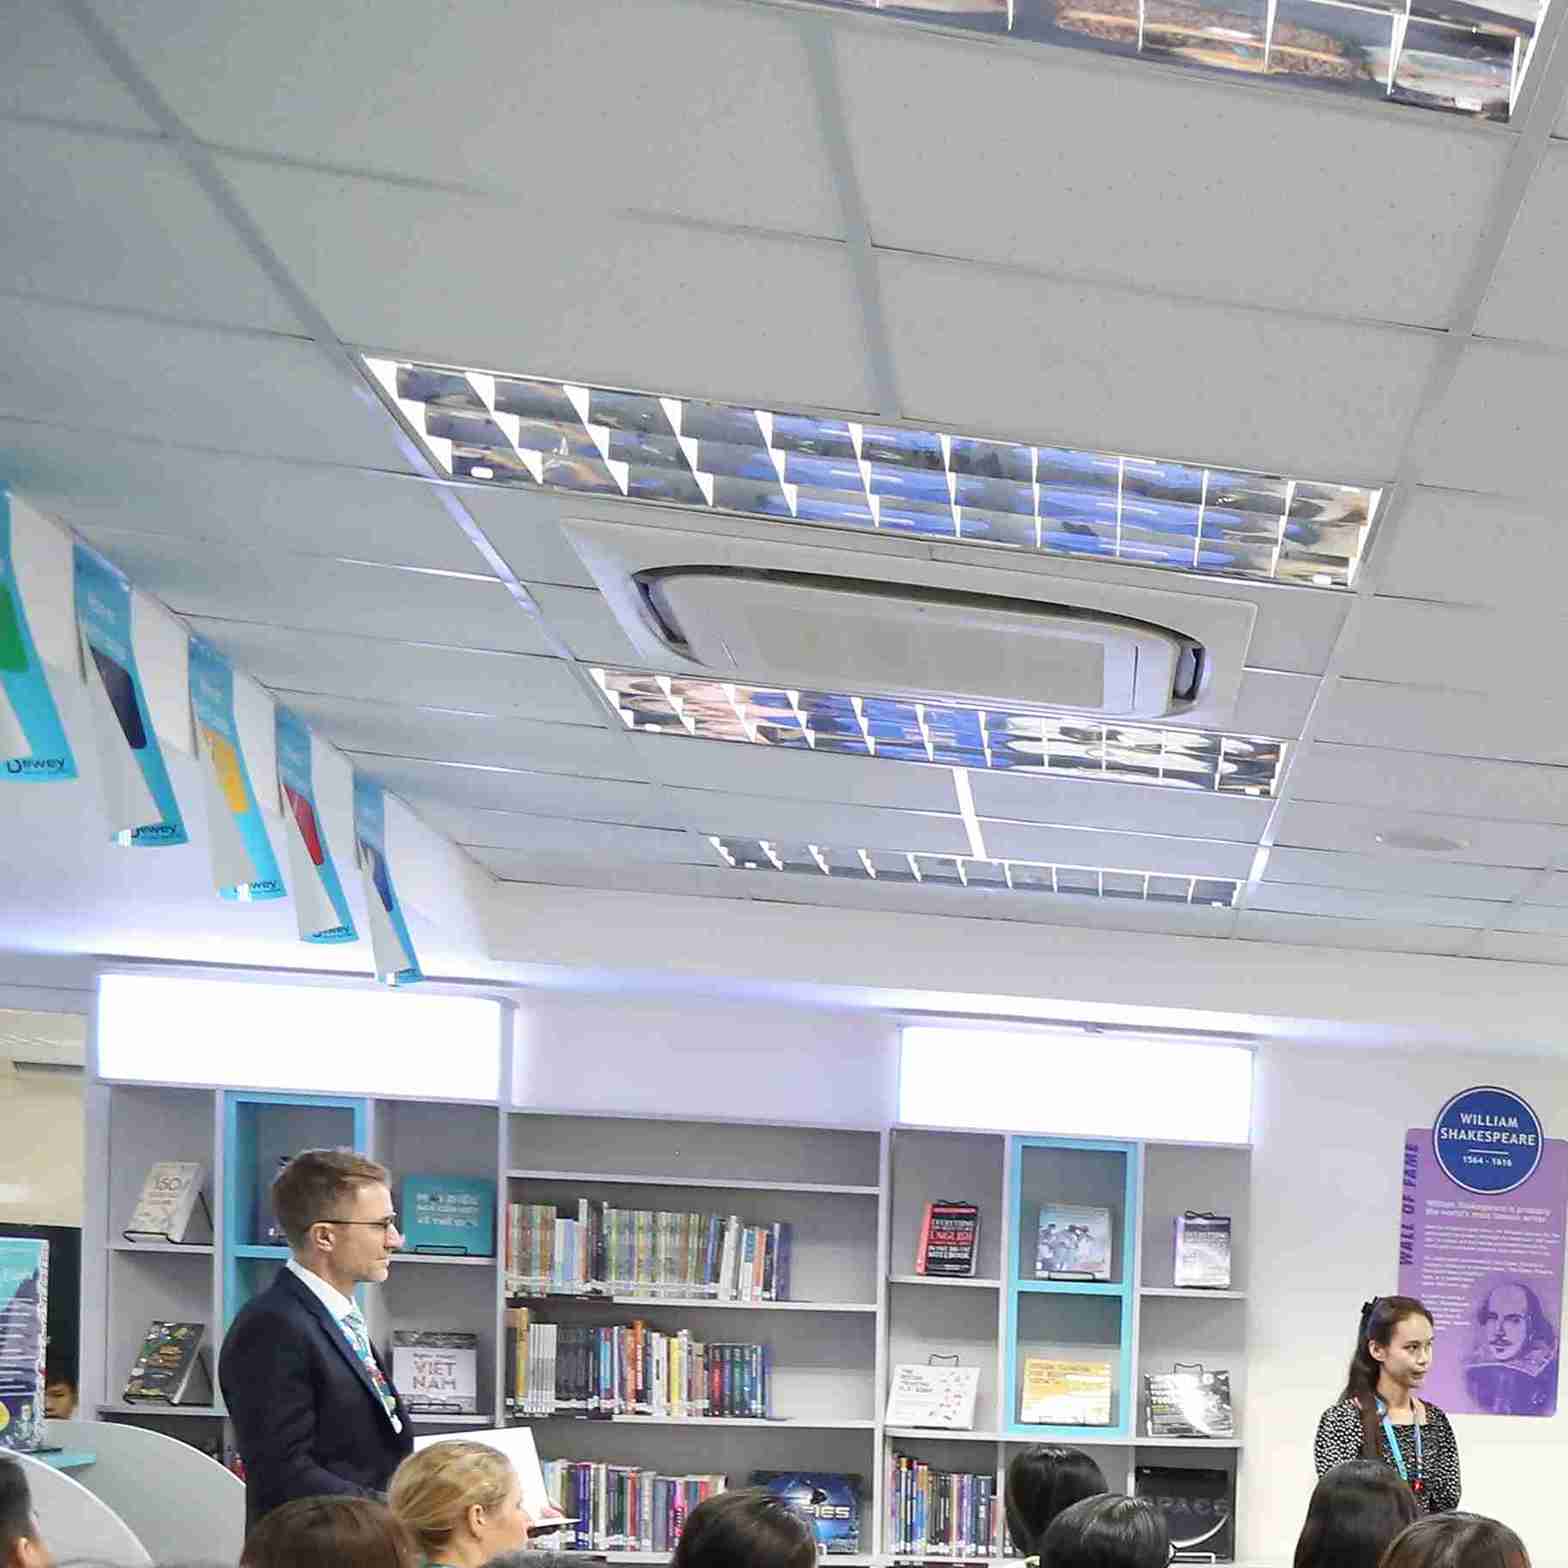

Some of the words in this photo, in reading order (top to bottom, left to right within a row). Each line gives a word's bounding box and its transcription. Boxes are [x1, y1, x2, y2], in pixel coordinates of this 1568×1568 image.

[1459, 1112, 1519, 1129] WILLIAM
[1440, 1127, 1538, 1147] SHAKESPEARE
[1403, 1143, 1419, 1188] FAME
[1463, 1155, 1484, 1165] 1564
[1402, 1194, 1416, 1215] OF
[1400, 1223, 1416, 1265] WALL
